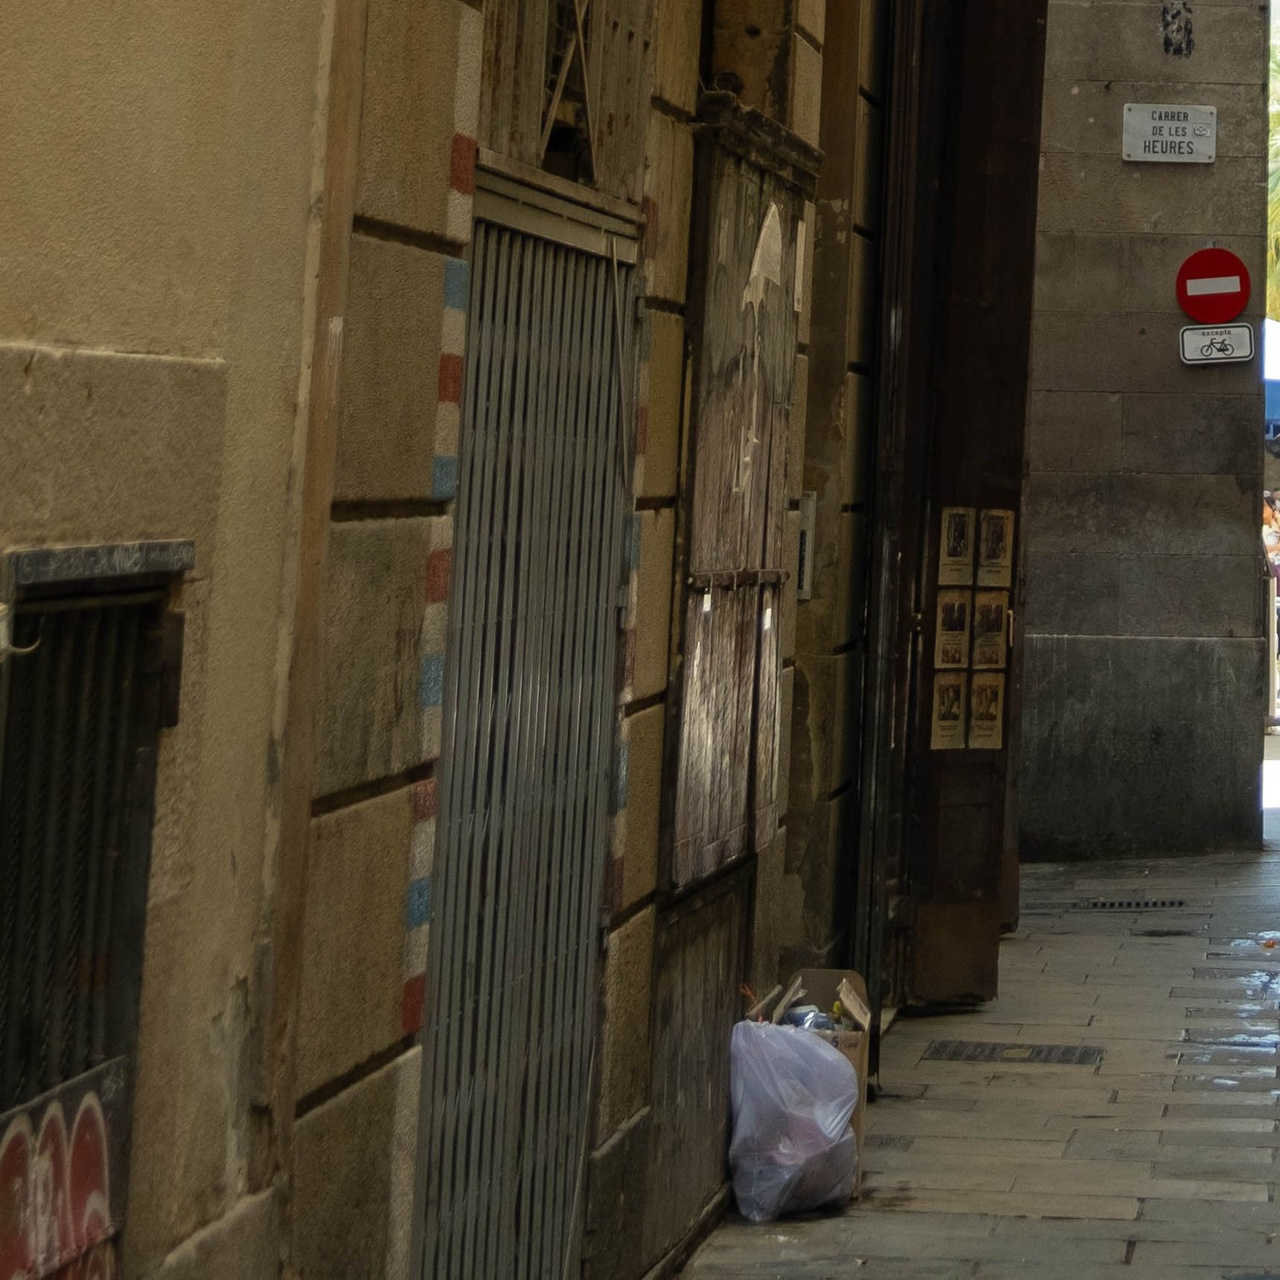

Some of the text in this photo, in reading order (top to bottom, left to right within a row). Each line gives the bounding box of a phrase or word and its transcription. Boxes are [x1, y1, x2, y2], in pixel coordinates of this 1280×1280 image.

[1151, 110, 1189, 123] CARRER
[1152, 126, 1188, 137] DE LES
[1143, 140, 1194, 155] HEURES
